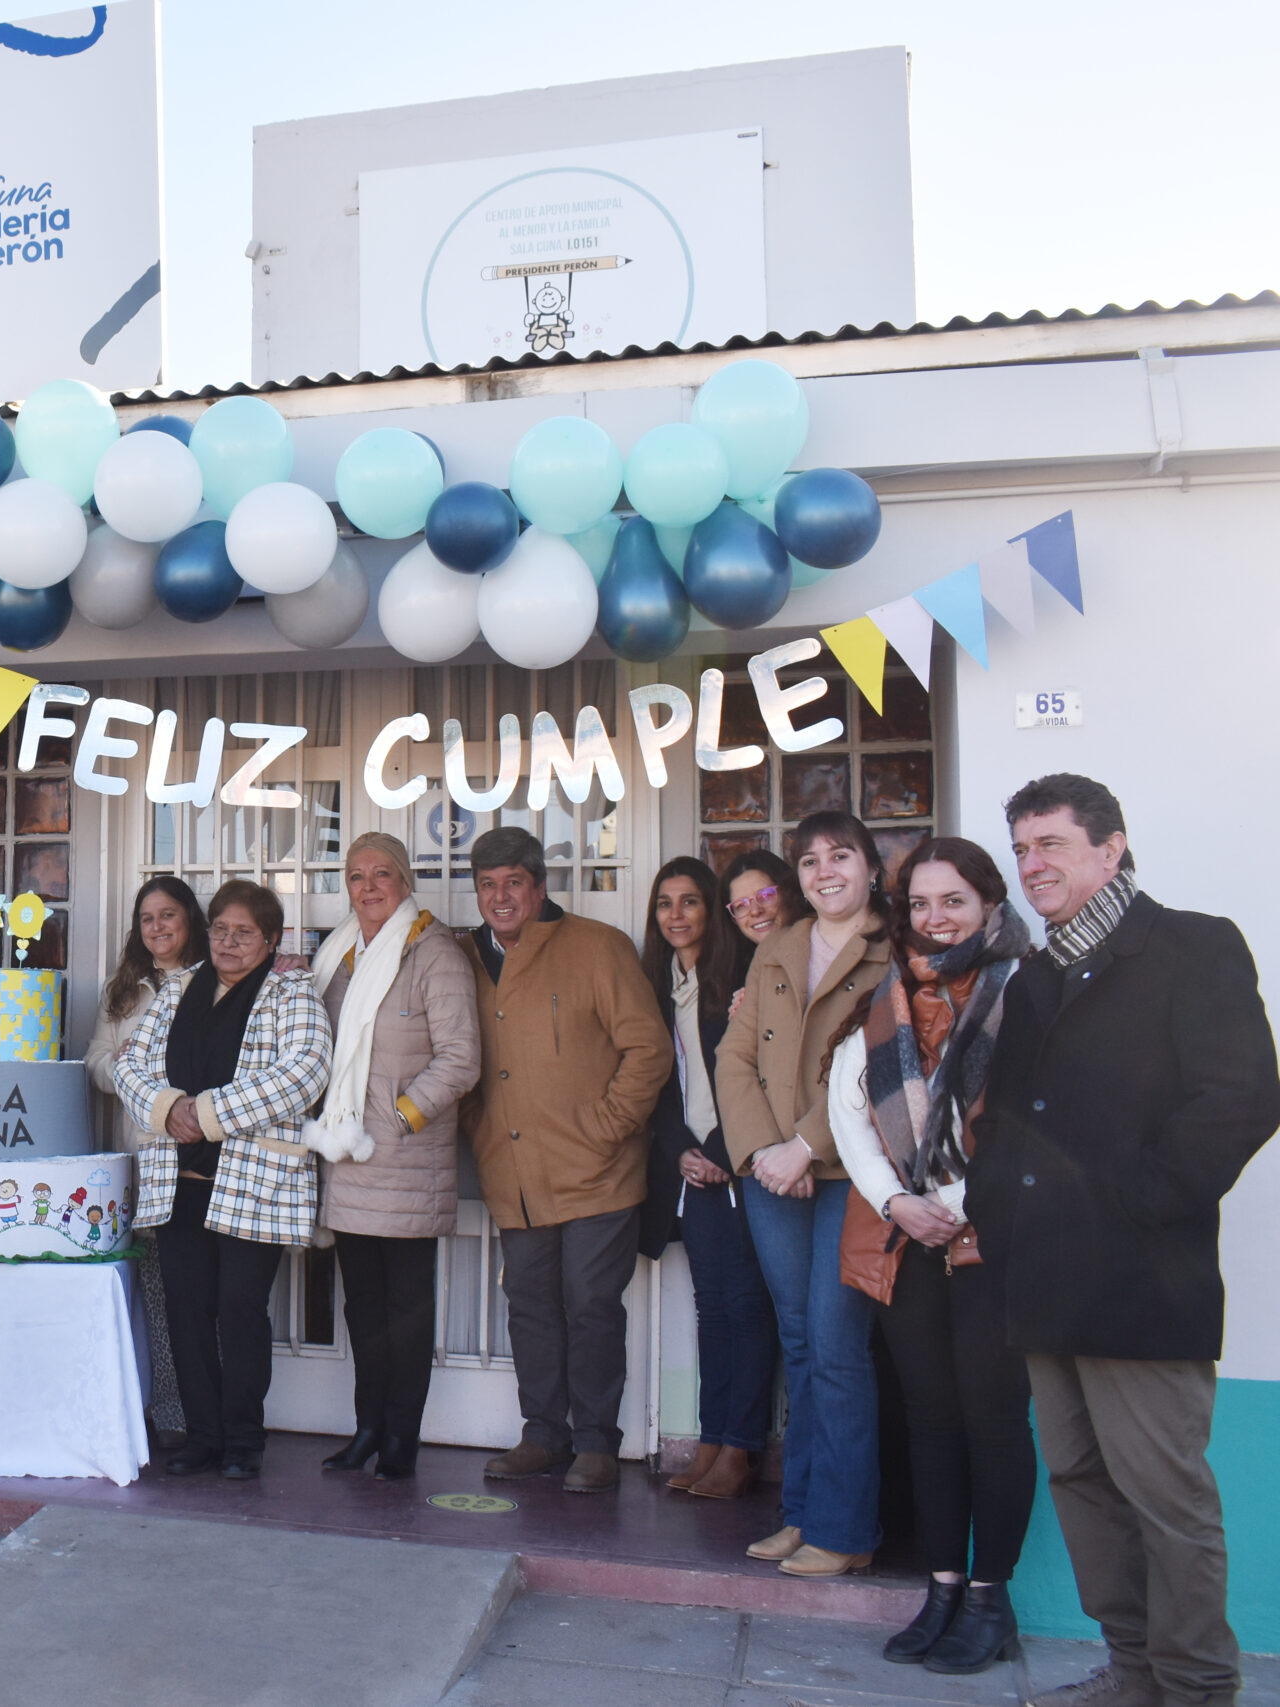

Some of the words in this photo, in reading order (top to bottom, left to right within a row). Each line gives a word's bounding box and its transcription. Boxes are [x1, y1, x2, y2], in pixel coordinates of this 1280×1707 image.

[485, 207, 521, 223] CENTRO
[524, 206, 537, 219] DE
[538, 201, 570, 217] APOYO
[571, 196, 624, 213] MUNICIPAL
[498, 227, 510, 239] AL
[513, 221, 546, 238] MENOR
[548, 223, 556, 233] Y
[557, 218, 570, 233] LA
[571, 215, 612, 231] FAMILIA
[509, 241, 535, 256] SALA
[536, 238, 563, 254] CUNA
[505, 264, 562, 277] PRESIDENTE
[564, 258, 599, 272] PERÓN
[1036, 692, 1065, 714] 65
[17, 683, 309, 809] FELIZ
[363, 637, 846, 813] CUMPLE
[1045, 717, 1069, 726] VIDAL
